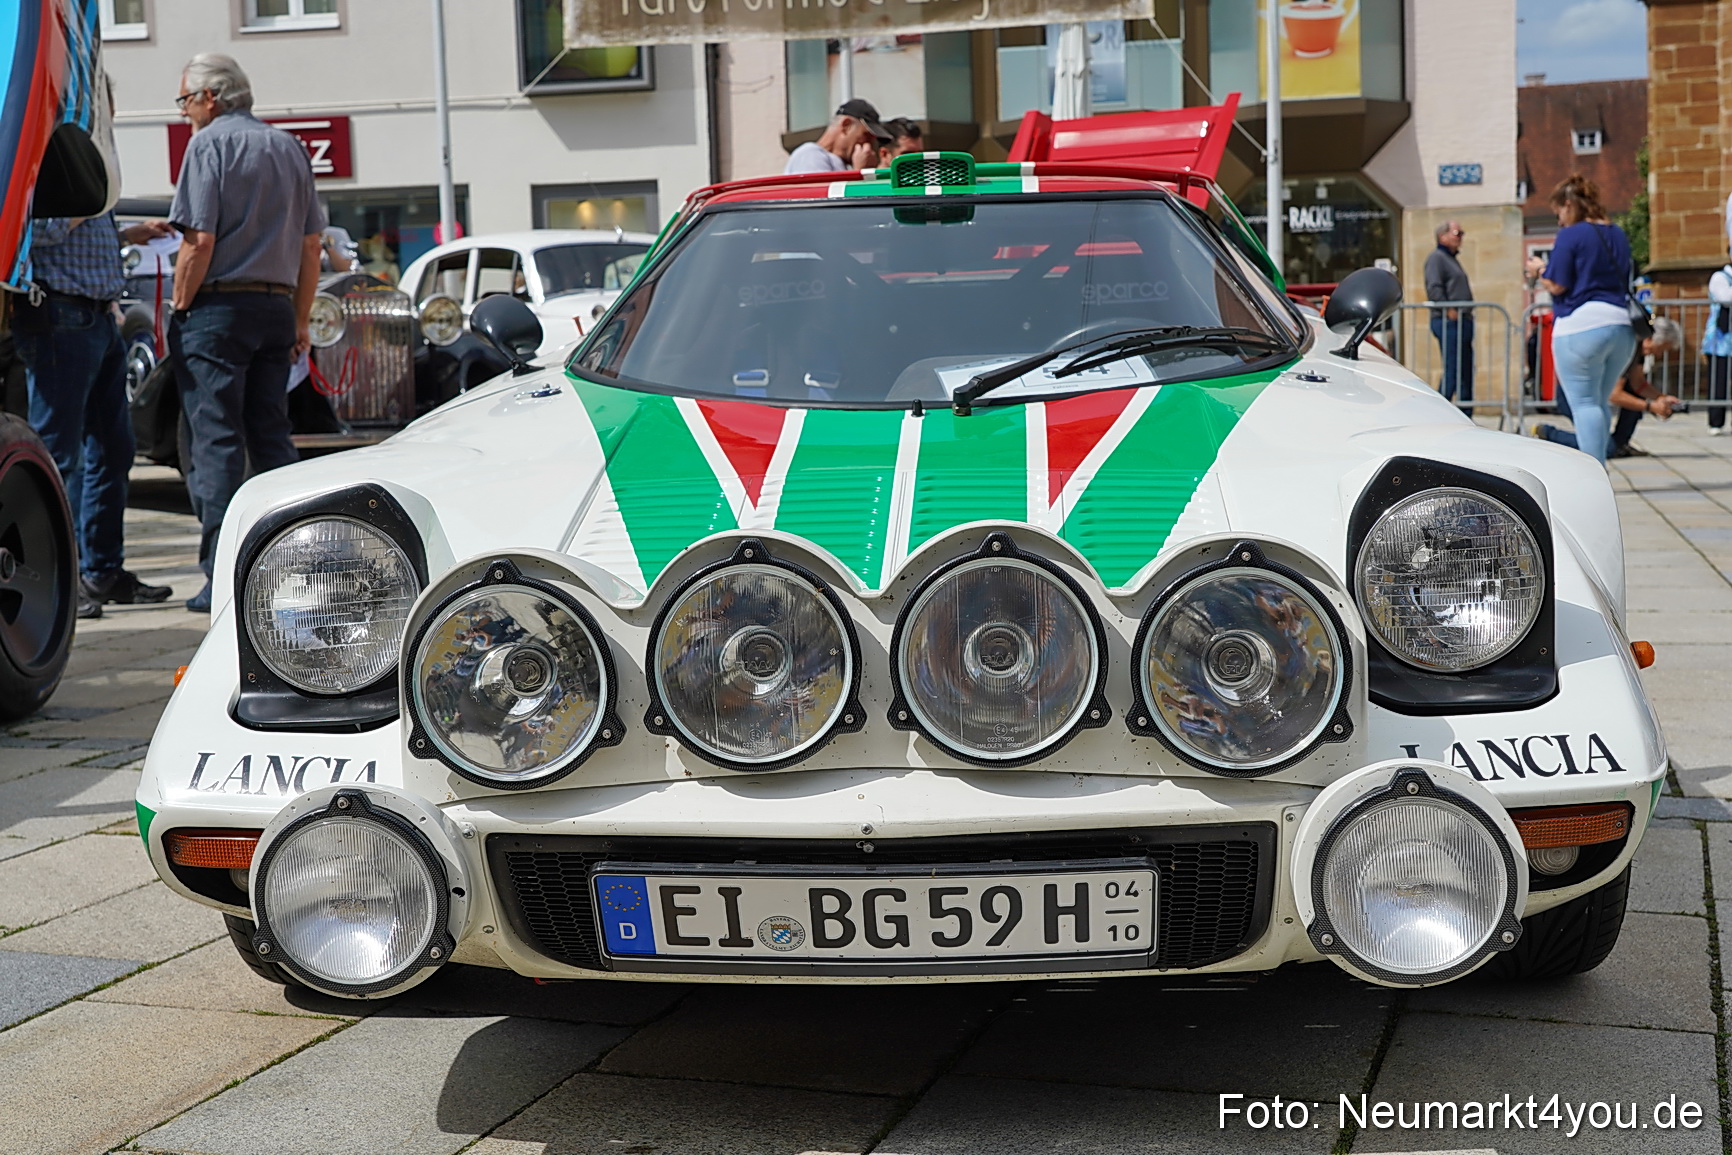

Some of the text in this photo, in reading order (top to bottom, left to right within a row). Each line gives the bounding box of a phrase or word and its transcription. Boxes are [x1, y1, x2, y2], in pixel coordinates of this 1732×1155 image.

[738, 278, 826, 307] sparco
[1082, 279, 1169, 306] sparco
[1105, 882, 1140, 898] 04
[659, 886, 754, 947] EI
[809, 888, 909, 949] BG
[619, 922, 637, 940] D
[1108, 926, 1140, 942] 10
